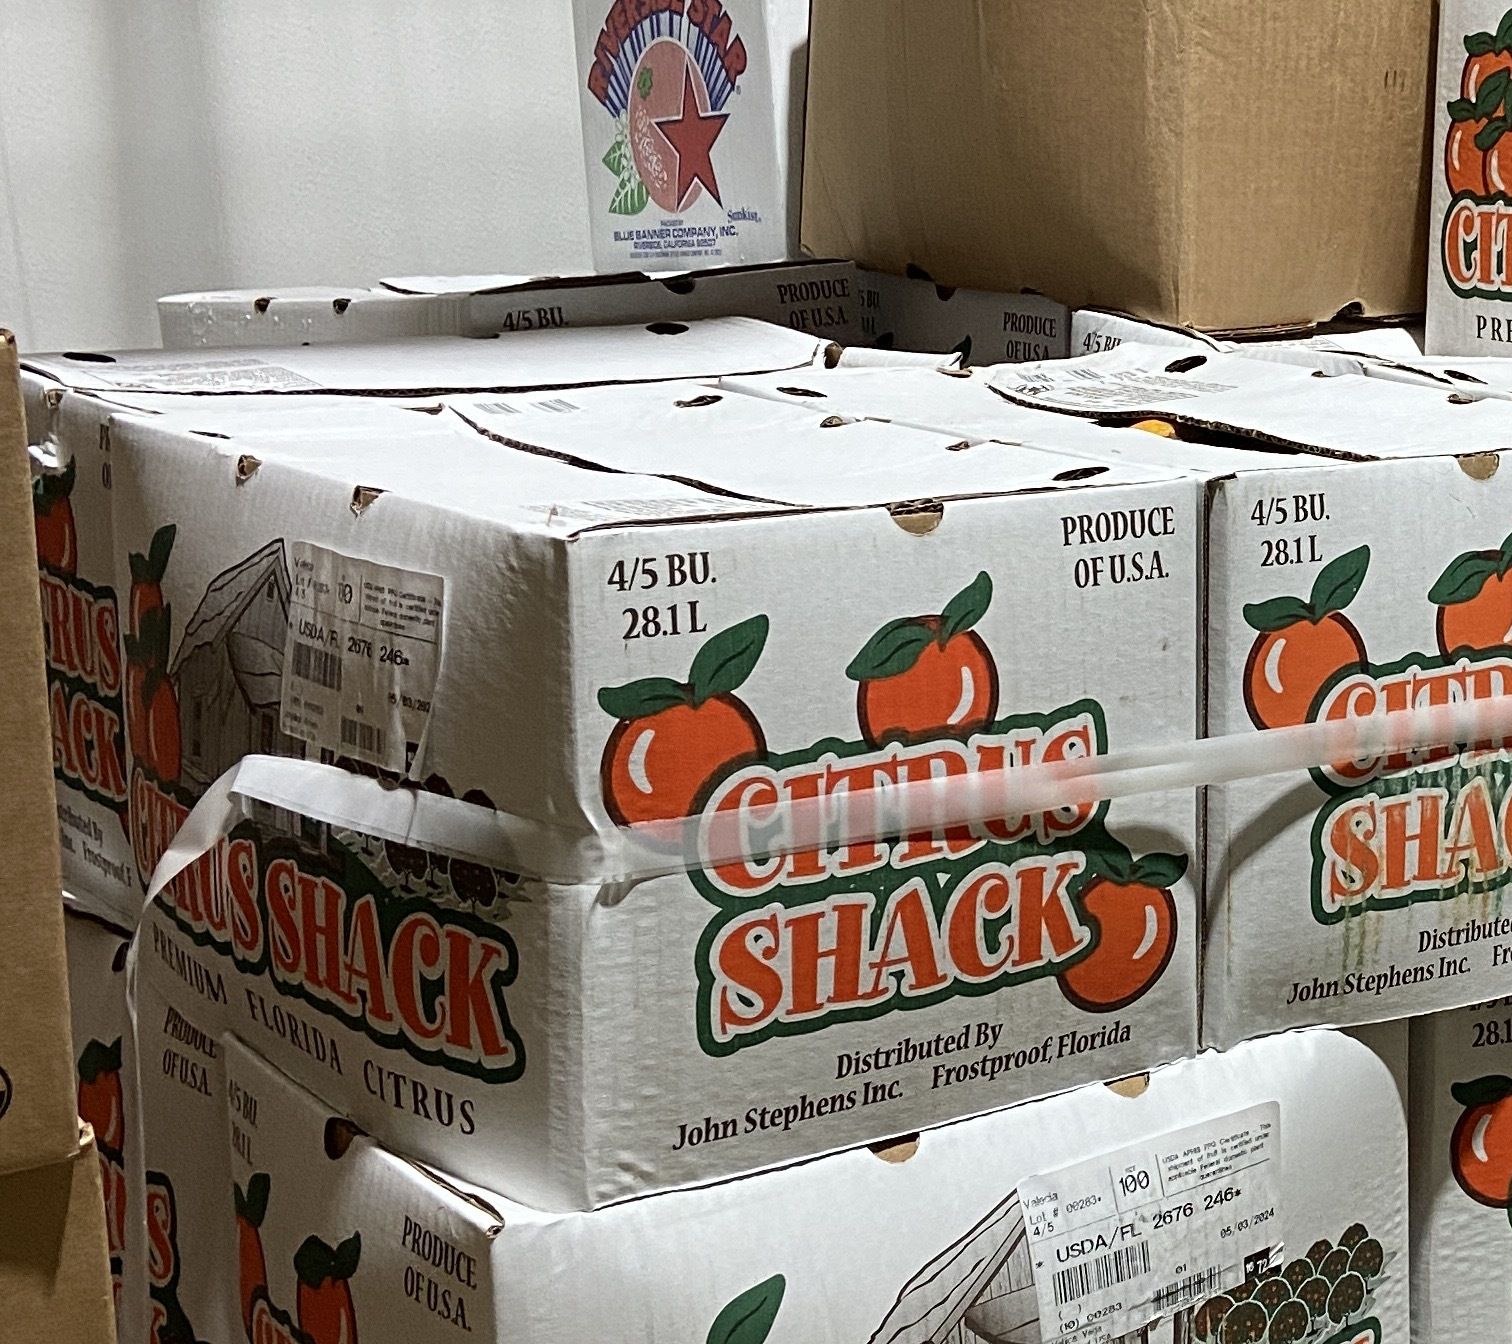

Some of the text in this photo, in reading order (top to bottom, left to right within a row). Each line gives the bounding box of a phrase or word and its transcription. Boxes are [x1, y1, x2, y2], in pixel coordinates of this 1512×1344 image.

[778, 278, 849, 304] PRODUCE
[1003, 312, 1056, 337] PRODUCE
[1061, 506, 1176, 547] PRODUCE
[1250, 493, 1330, 526] 4/5 BU.
[607, 552, 717, 592] 4/5 BU.
[1074, 551, 1170, 589] OF U.S.A.
[1260, 536, 1304, 568] 28.1
[622, 602, 683, 640] 28.1
[267, 857, 510, 1060] SHACK
[719, 861, 1090, 1035] SHACK
[1287, 978, 1338, 1005] John
[1343, 961, 1435, 999] Stephens
[1438, 954, 1471, 977] Inc.
[152, 924, 476, 1135] PREMIUM FLORIDA CITRUS
[835, 1020, 1004, 1080] Distributed By
[673, 1022, 1132, 1151] John Stephens Inc. Florida
[1119, 1170, 1149, 1196] 100
[1029, 1214, 1046, 1225] Lot
[1056, 1224, 1142, 1263] USDA/FL
[1153, 1203, 1194, 1229] 2676
[401, 1213, 478, 1290] PRODUCE
